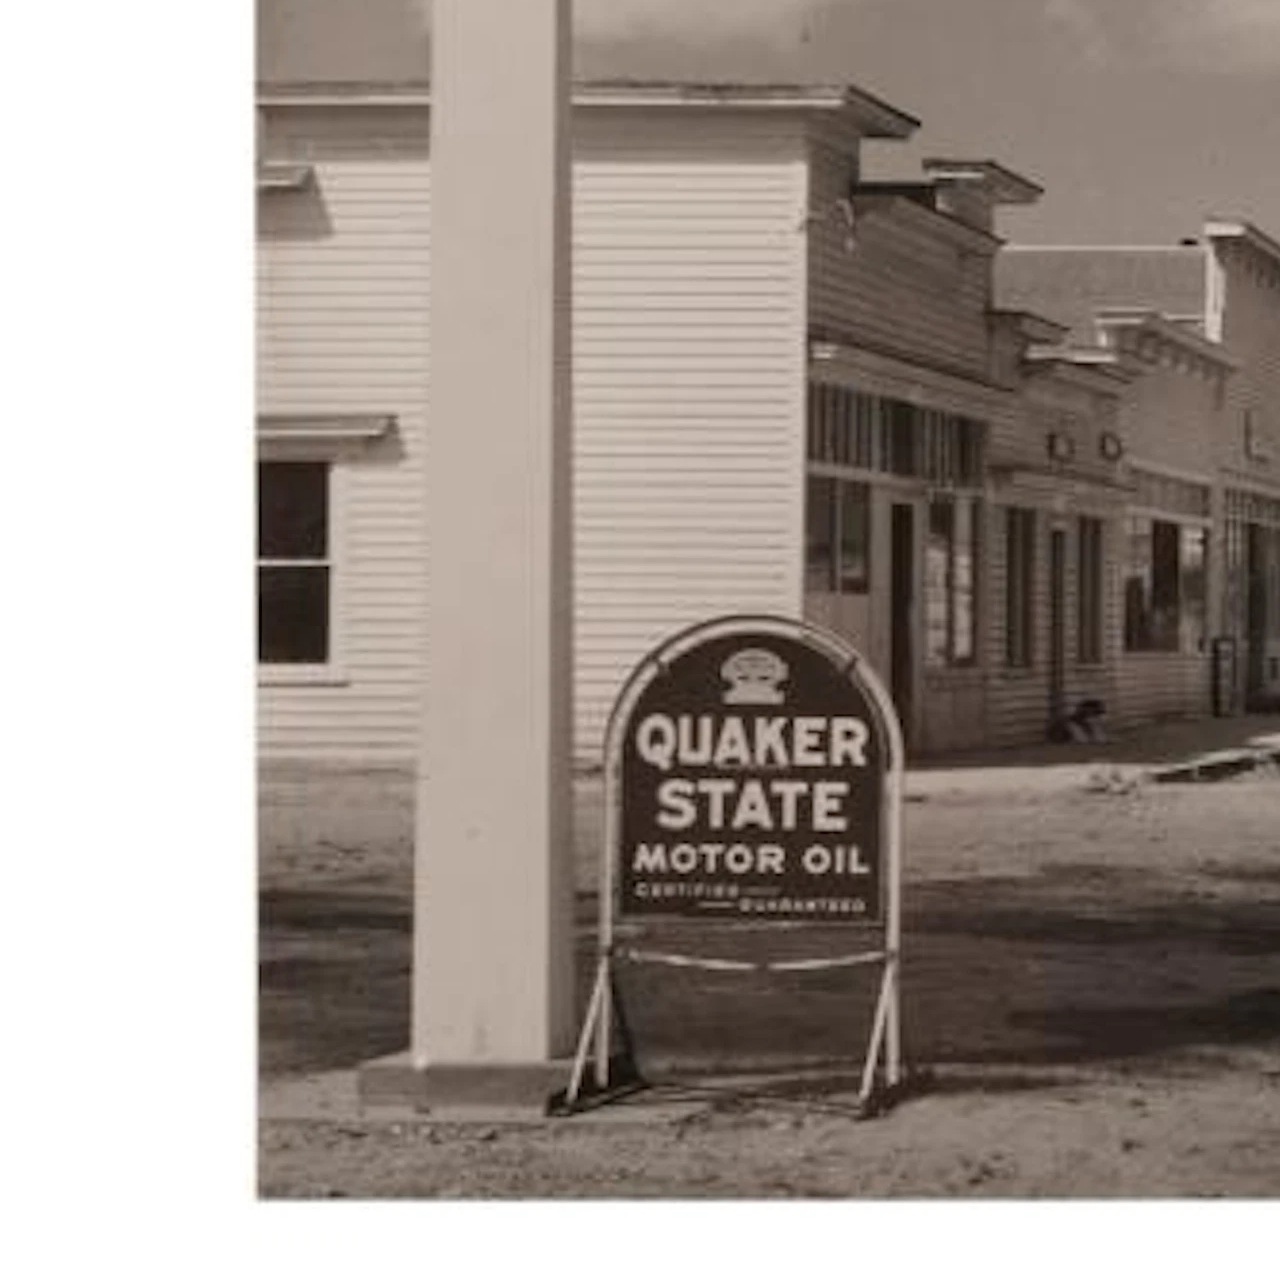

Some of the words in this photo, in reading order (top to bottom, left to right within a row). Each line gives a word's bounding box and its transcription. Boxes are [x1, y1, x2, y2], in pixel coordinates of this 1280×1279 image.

[634, 713, 868, 771] QUAKER
[656, 778, 850, 832] STATE
[631, 841, 787, 875] MOTOR
[801, 842, 871, 875] OIL
[633, 881, 740, 898] CERTIFIED
[738, 897, 867, 913] GUARANTEED
